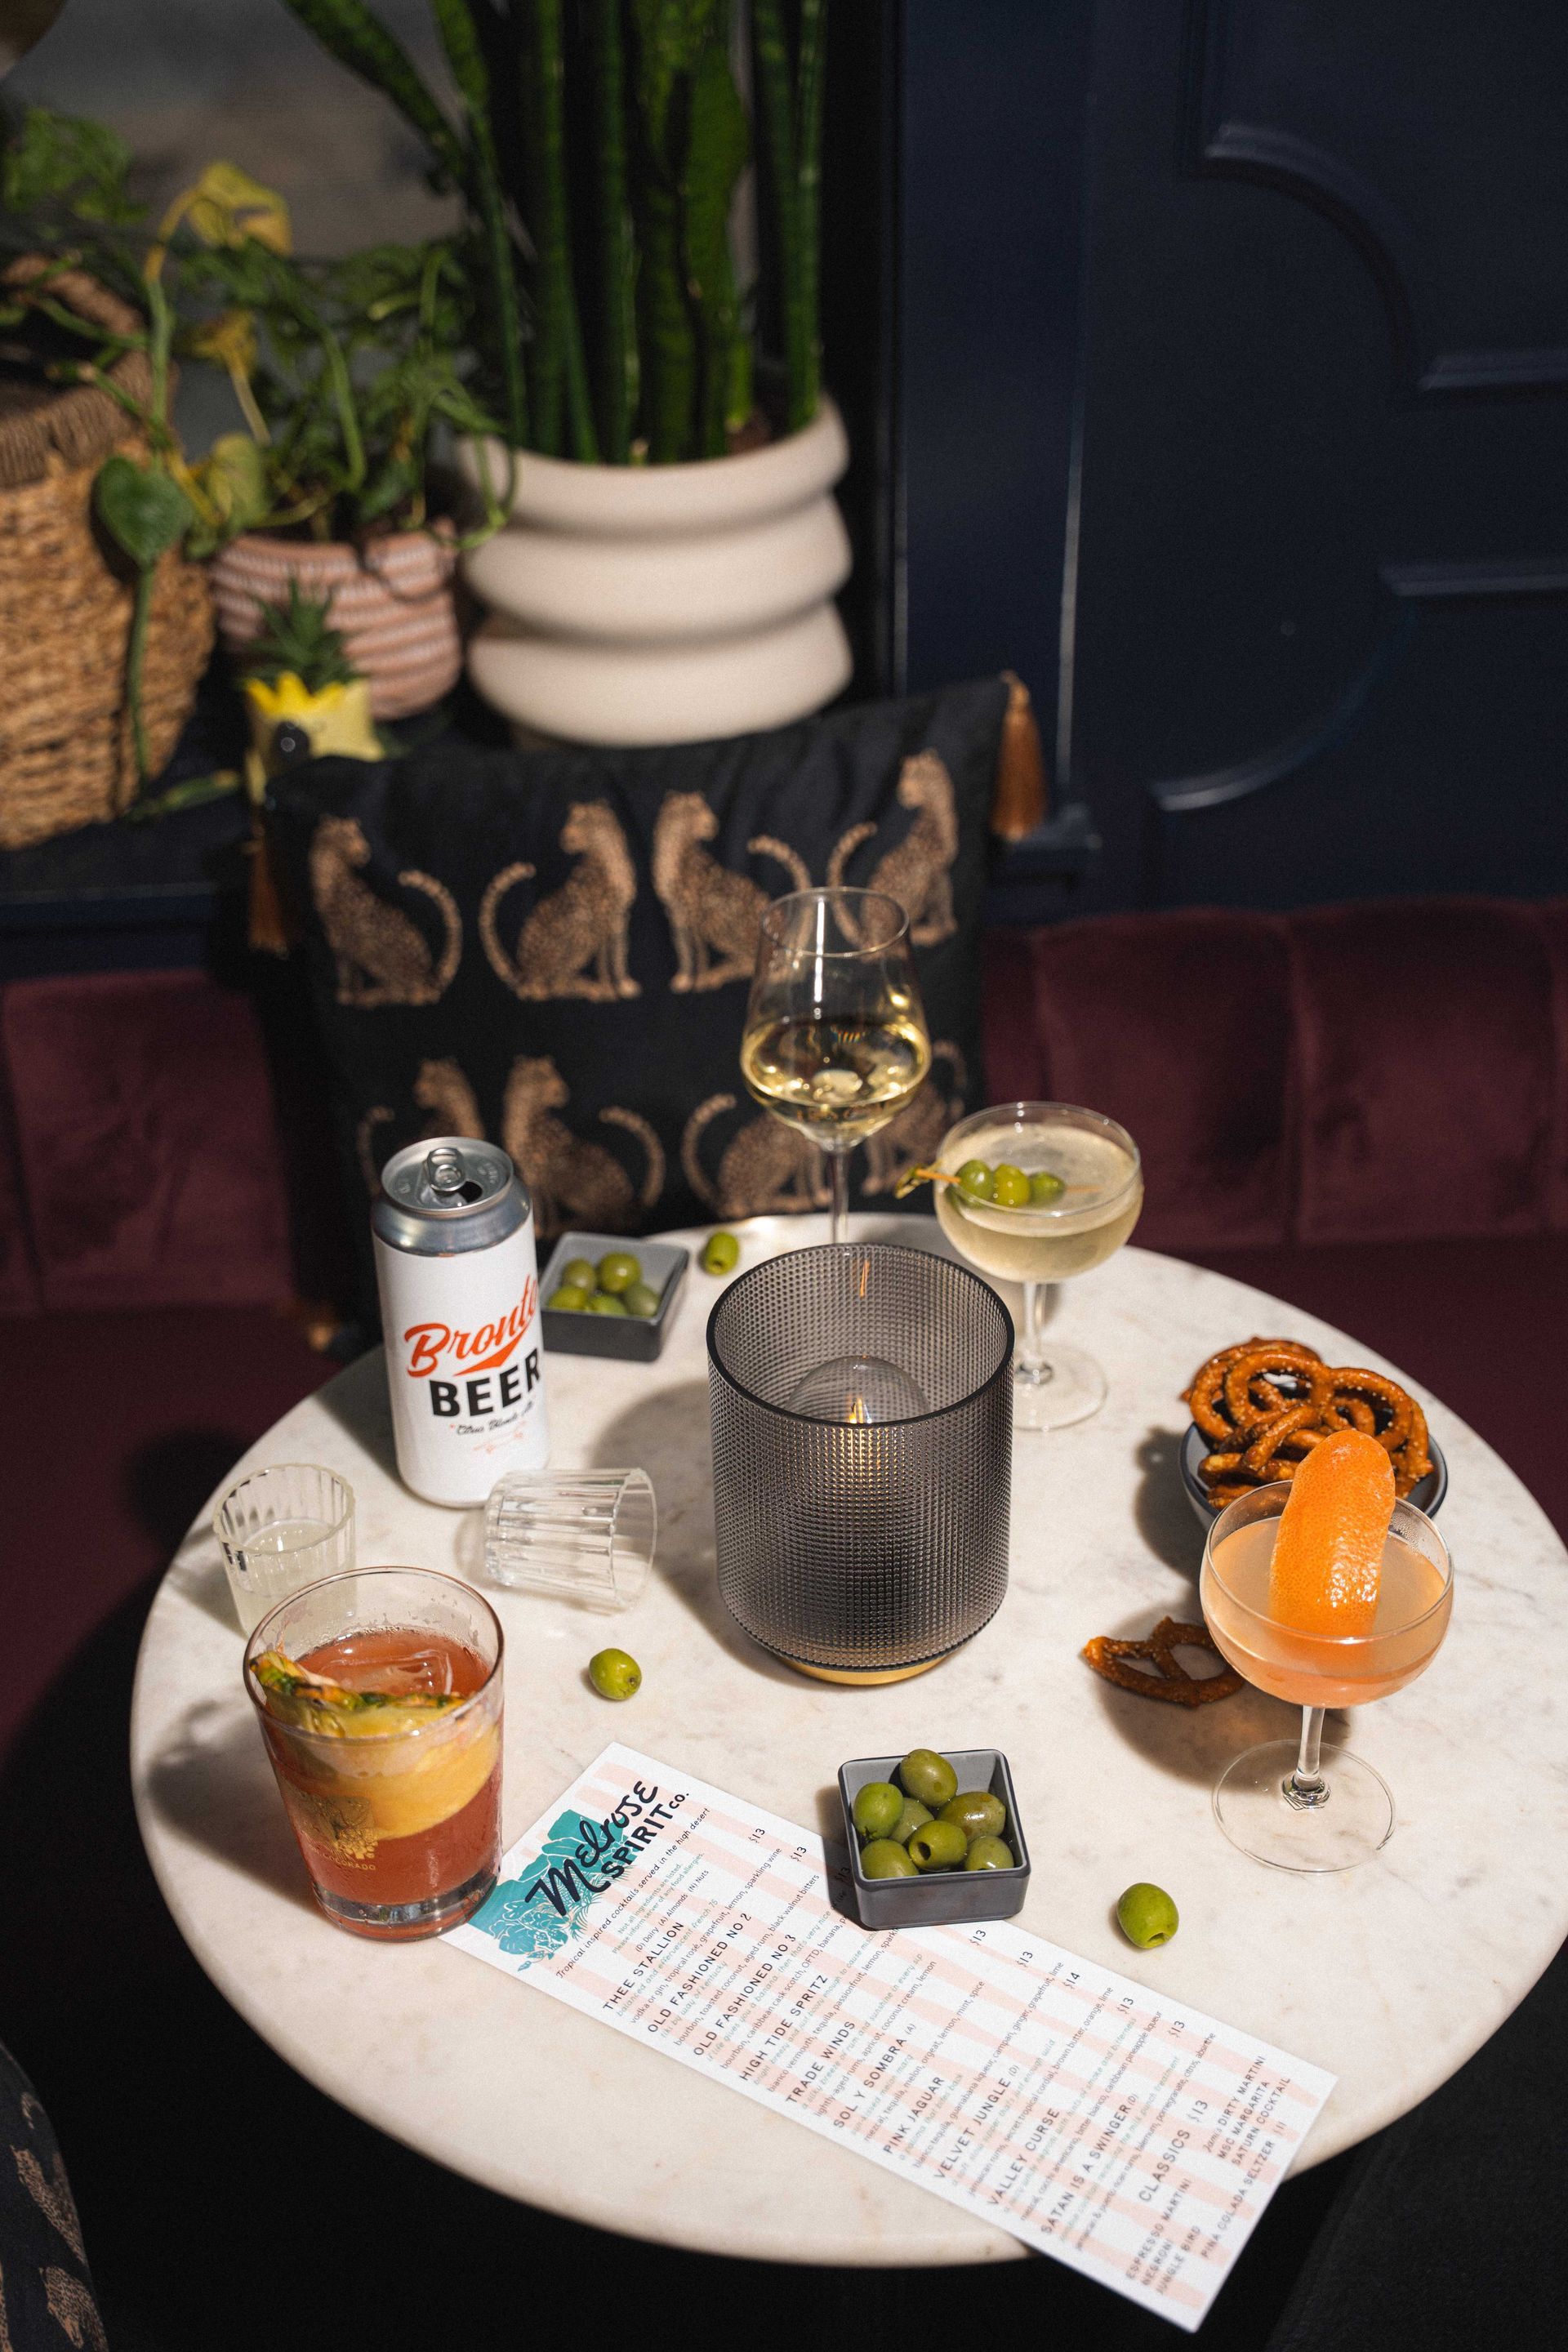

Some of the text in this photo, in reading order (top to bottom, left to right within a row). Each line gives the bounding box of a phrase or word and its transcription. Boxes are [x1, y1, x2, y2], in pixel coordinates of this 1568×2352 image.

[429, 1348, 540, 1418] BEER
[524, 1780, 659, 1917] Melrose
[600, 1802, 675, 1879] SPIRIT
[555, 1806, 710, 1979] Tropical inspired cocktails served in the high desert
[610, 1935, 631, 1954] Please
[626, 1916, 647, 1937] inform
[642, 1900, 660, 1919] server
[669, 1872, 686, 1887] food
[629, 1846, 782, 2024] vodka or gin, tropical rosé, grapefruit, lemon, sparkling wine
[631, 1886, 663, 1917] ingredients
[641, 1926, 660, 1944] Dairy
[665, 1892, 693, 1918] Almonds
[693, 1869, 710, 1884] Nuts
[601, 1978, 635, 2010] THEE
[632, 1921, 684, 1977] STALLION
[646, 2007, 672, 2033] OLD
[668, 1940, 728, 2007] FASHIONED
[724, 1922, 744, 1939] NO
[739, 1912, 752, 1922] 2
[672, 1873, 820, 2047] bourbon, toasted coconut, aged rum, black walnut bitters
[692, 2030, 718, 2056] OLD
[714, 1962, 773, 2029] FASHIONED
[769, 1943, 789, 1961] NO
[783, 1933, 796, 1942] 3
[718, 2039, 751, 2069] bourbon,
[746, 2005, 776, 2039] caribbean
[771, 1989, 788, 2007] cask
[782, 1968, 808, 1992] scotch,
[816, 1920, 844, 1949] banana,
[784, 2035, 818, 2069] vermouth,
[811, 2009, 838, 2035] tequila,
[831, 1970, 868, 2011] passionfruit,
[860, 1948, 885, 1971] lemon,
[860, 2031, 886, 2057] apricot,
[880, 2002, 906, 2031] coconut
[900, 1982, 923, 2005] cream,
[914, 1960, 938, 1983] lemon
[737, 1974, 829, 2082] HIGH TIDE SPRITZ
[784, 2020, 856, 2103] TRADE WINDS
[881, 2088, 909, 2115] tequila,
[902, 2064, 926, 2089] melon,
[920, 2039, 944, 2067] orgeat,
[936, 2016, 961, 2040] lemon,
[954, 1995, 974, 2018] mint,
[968, 1978, 987, 1999] spice
[929, 2119, 955, 2145] tequila,
[1011, 2007, 1033, 2032] ginger,
[1027, 1976, 1056, 2011] grapefruit,
[1046, 1961, 1064, 1977] lime
[1002, 2118, 1023, 2143] secret
[1016, 2091, 1040, 2123] tropical
[1035, 2069, 1059, 2095] cordial,
[1049, 2047, 1072, 2070] brown
[1064, 2025, 1089, 2049] butter,
[1082, 2002, 1106, 2026] orange,
[1097, 1985, 1114, 2003] lime
[832, 2104, 859, 2128] SOL
[853, 2089, 866, 2099] Y
[862, 2038, 907, 2088] SOMBRA
[881, 2123, 911, 2154] PINK
[906, 2075, 945, 2123] JAGUAR
[1216, 2095, 1241, 2127] DIRTY
[1236, 2054, 1267, 2096] MARTINI
[1216, 2080, 1271, 2159] MSC MARGARITA
[1230, 2077, 1291, 2167] SATURN COCKTAIL
[933, 2126, 975, 2179] VELVET
[986, 2153, 1028, 2206] VALLEY
[1023, 2106, 1060, 2152] CURSE
[1040, 2190, 1076, 2235] SATAN
[1069, 2174, 1085, 2189] IS
[1080, 2163, 1094, 2174] A
[1088, 2103, 1132, 2160] SWINGER
[1137, 2128, 1191, 2203] CLASSICS
